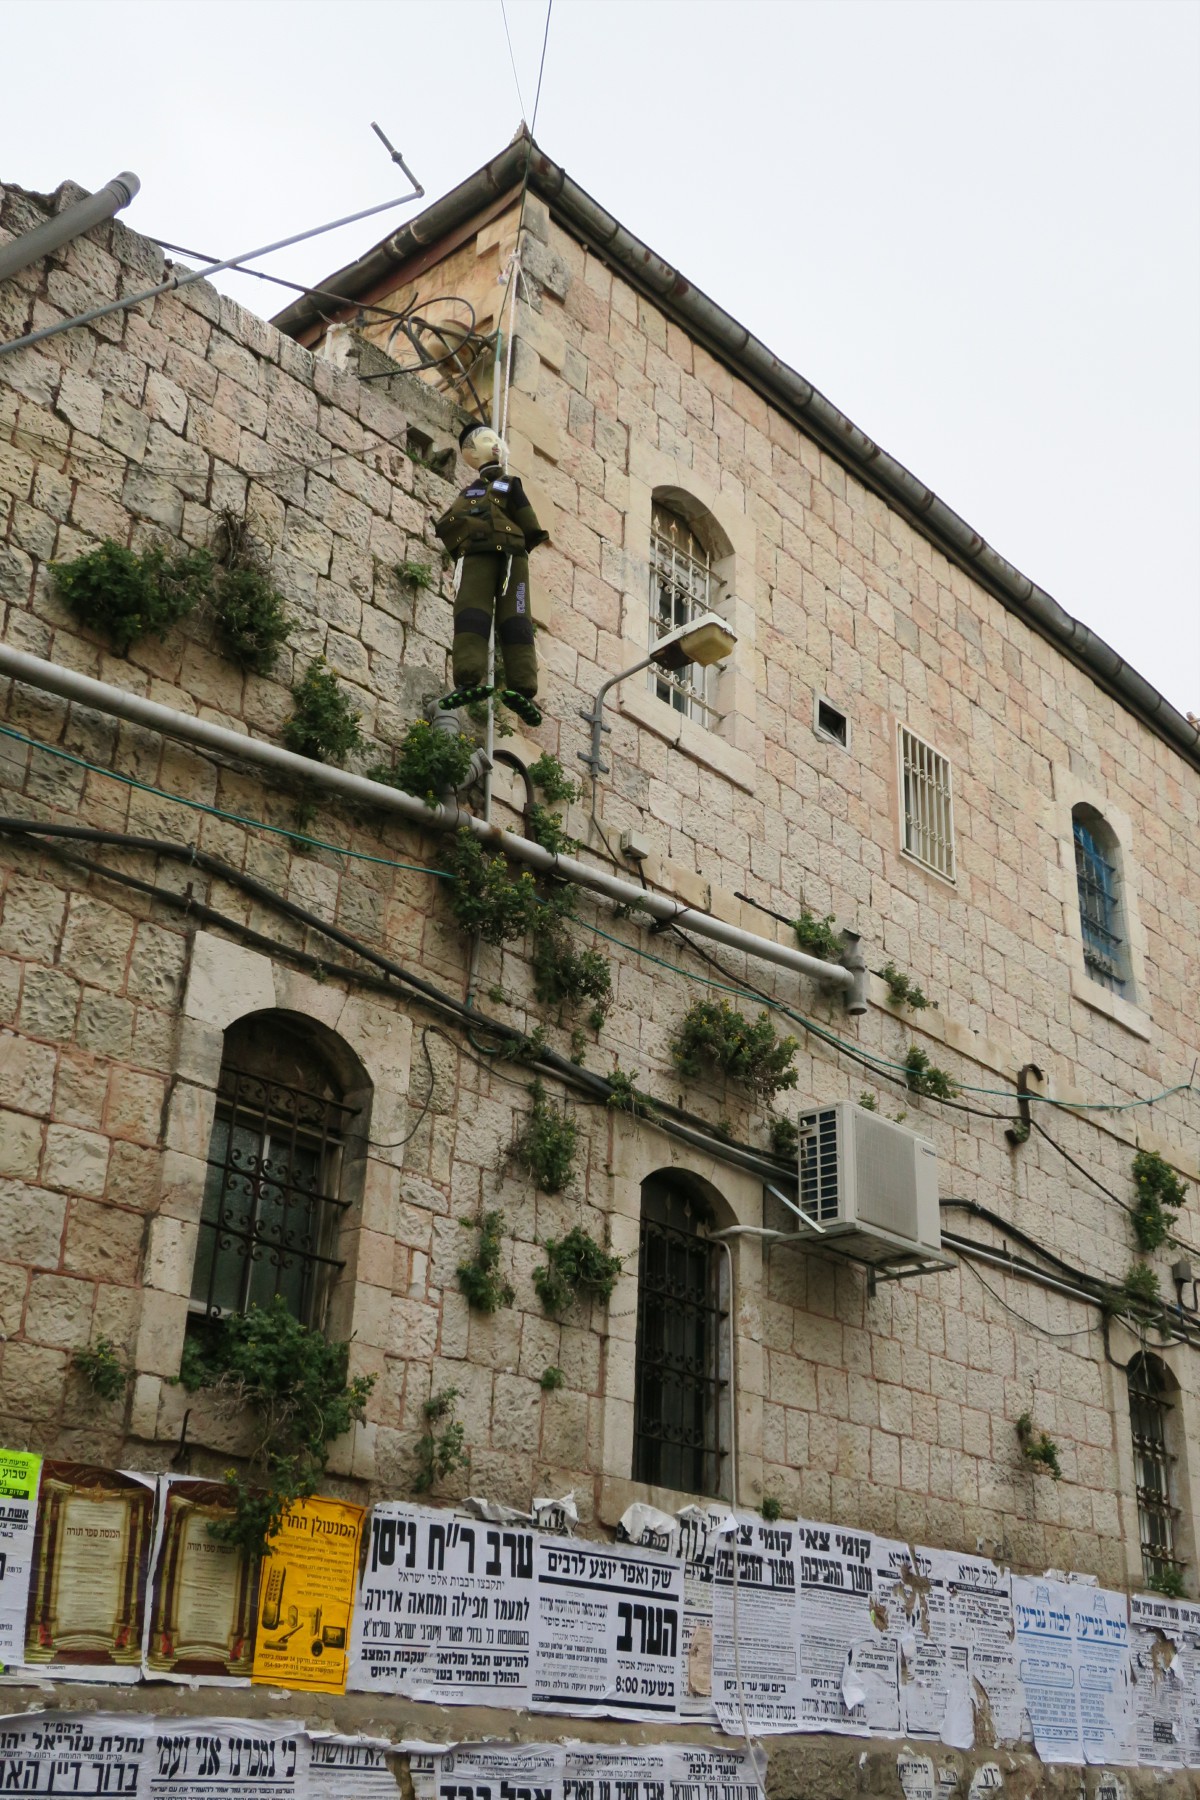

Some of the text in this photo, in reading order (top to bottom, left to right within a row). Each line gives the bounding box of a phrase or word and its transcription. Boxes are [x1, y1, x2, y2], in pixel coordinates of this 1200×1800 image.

[2, 1468, 26, 1479] שבוע
[8, 1508, 29, 1519] אשת
[66, 1527, 120, 1539] הכנסת ספר תורה
[311, 1516, 356, 1538] המנעולן
[187, 1542, 201, 1551] תורה
[202, 1543, 216, 1552] ספר
[372, 1518, 416, 1572] ניסן
[428, 1522, 475, 1574] ר"ח
[759, 1528, 792, 1557] קומי
[799, 1528, 871, 1564] קומי צאי
[486, 1531, 533, 1579] ערב
[548, 1552, 586, 1576] לרבים
[398, 1568, 504, 1591] יתקבצו רבבות אלפי ישראל
[589, 1559, 616, 1579] יוצע
[621, 1563, 648, 1585] ואפר
[652, 1568, 672, 1590] שק
[768, 1558, 794, 1587] מתוך
[801, 1556, 873, 1591] מתוך ההפיכה!
[959, 1564, 997, 1589] קול קורא
[365, 1589, 402, 1612] אדירה
[408, 1592, 447, 1616] ומחאה
[452, 1592, 488, 1618] תפילה
[494, 1597, 529, 1621] למעמד
[1016, 1604, 1046, 1629] נגרע?
[1049, 1605, 1070, 1632] למה
[1076, 1613, 1126, 1640] למה נגרע?
[394, 1621, 416, 1639] ישראל
[617, 1602, 677, 1657] הערב
[361, 1648, 529, 1668] להרעיש תבל המצב
[637, 1661, 655, 1672] תענית
[456, 1670, 489, 1682] ומחמיר
[493, 1670, 520, 1684] ההולך
[616, 1676, 674, 1697] בשעה 8:00
[759, 1682, 770, 1692] שני
[811, 1678, 822, 1688] ניסן
[772, 1683, 786, 1693] ביום
[32, 1732, 144, 1753] נחלת עזריאל
[106, 1754, 122, 1762] קרית
[157, 1736, 190, 1779] ועמי
[196, 1736, 221, 1775] אני
[282, 1740, 296, 1777] כי
[683, 1753, 706, 1761] הוראה
[709, 1753, 724, 1762] ובית
[48, 1762, 82, 1791] דיין
[92, 1763, 139, 1792] ברוך
[689, 1762, 737, 1775] שערי הלכה
